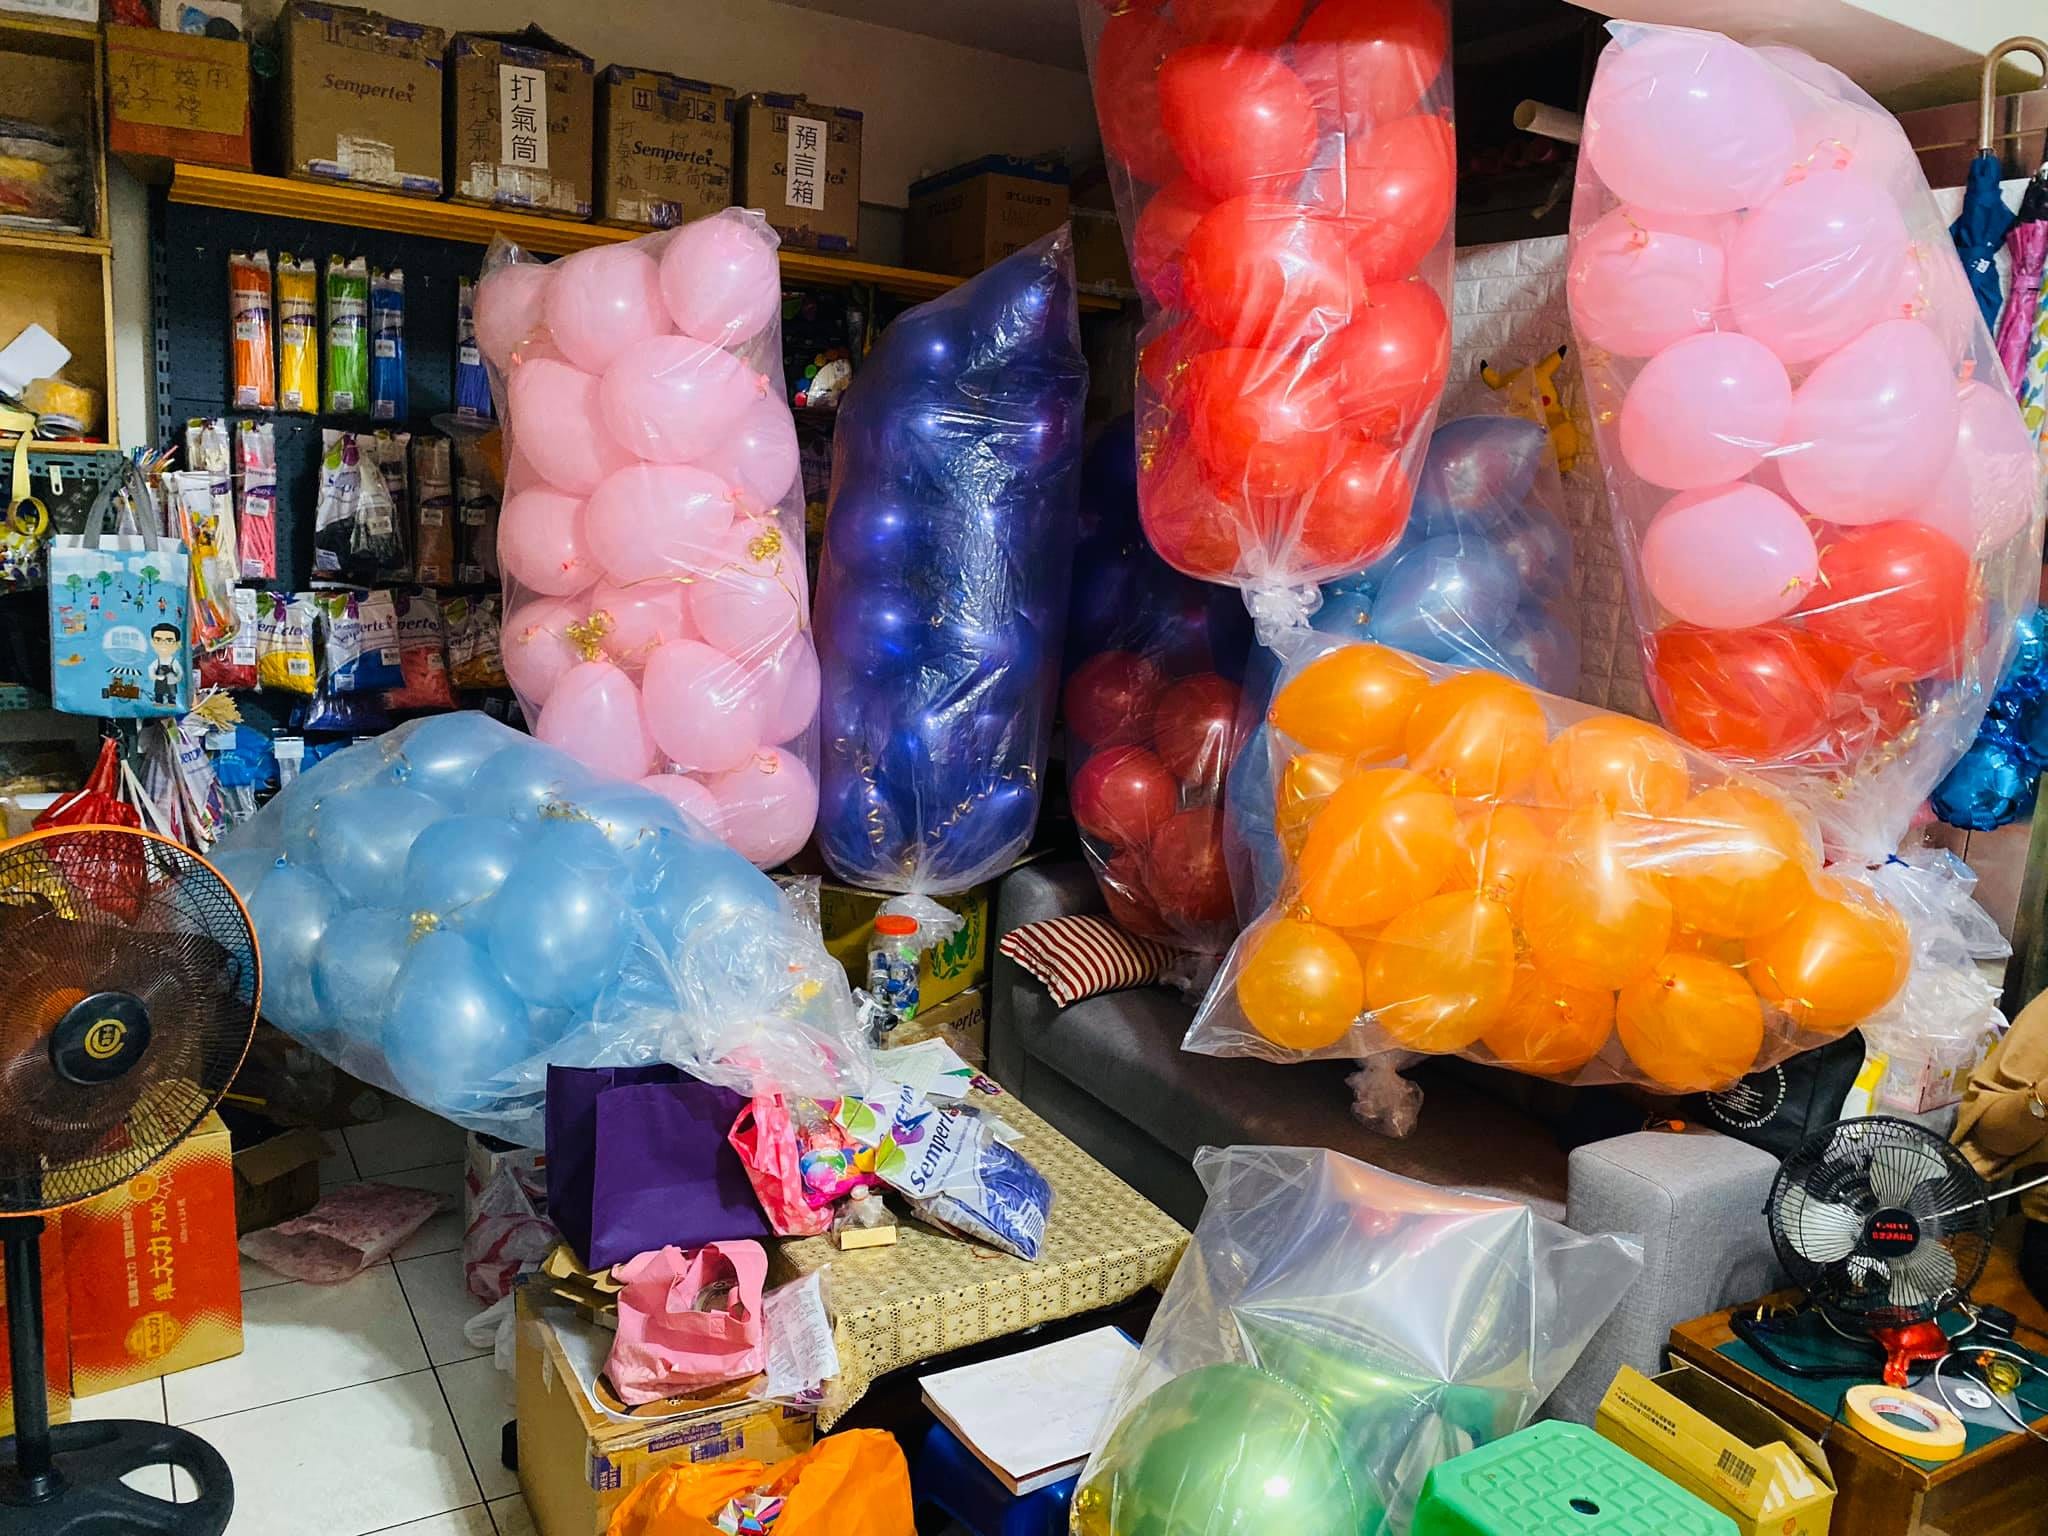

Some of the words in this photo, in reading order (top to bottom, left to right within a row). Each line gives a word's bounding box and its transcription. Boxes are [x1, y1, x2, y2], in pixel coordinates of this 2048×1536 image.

[323, 73, 416, 103] Sempertex
[510, 73, 538, 164] 打氣筒
[632, 140, 713, 168] Sempertex
[790, 123, 819, 205] 預言箱
[910, 1109, 955, 1194] Sempert
